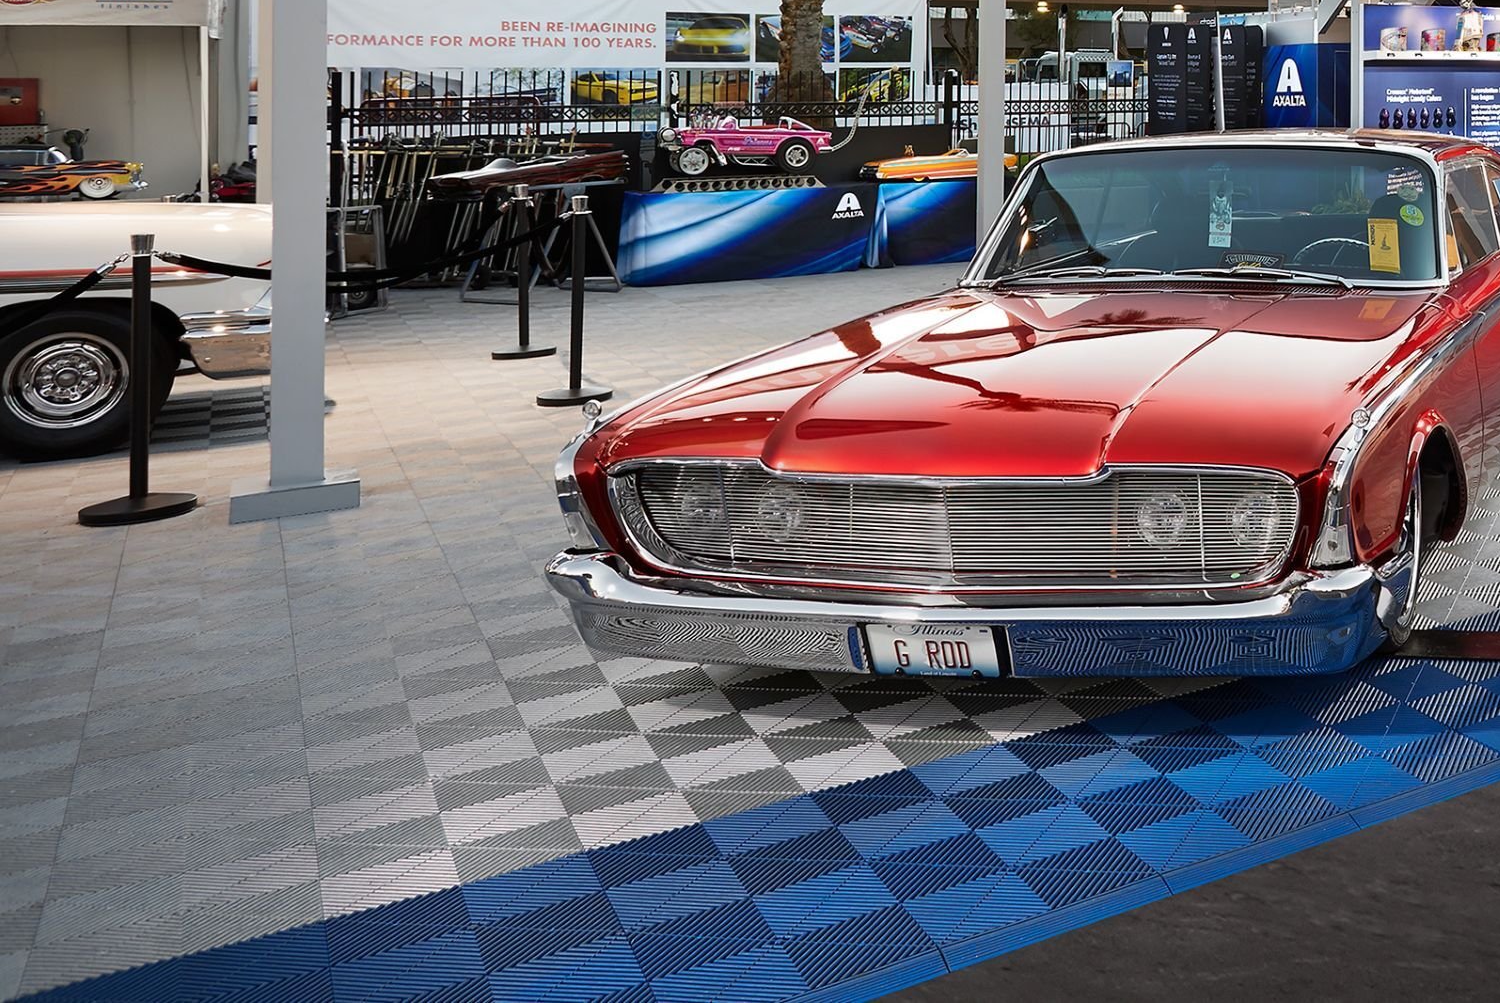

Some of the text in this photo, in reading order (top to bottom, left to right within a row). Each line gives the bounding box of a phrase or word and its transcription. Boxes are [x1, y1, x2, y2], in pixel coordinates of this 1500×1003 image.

[501, 21, 657, 34] BEEN RE-IMAGINING
[327, 34, 657, 49] FORMANCE FOR MORE THAN 100 YEARS.
[1272, 95, 1306, 107] AXALTA
[831, 210, 865, 219] AXALTA
[900, 624, 964, 636] Illinois
[894, 639, 972, 669] G ROD
